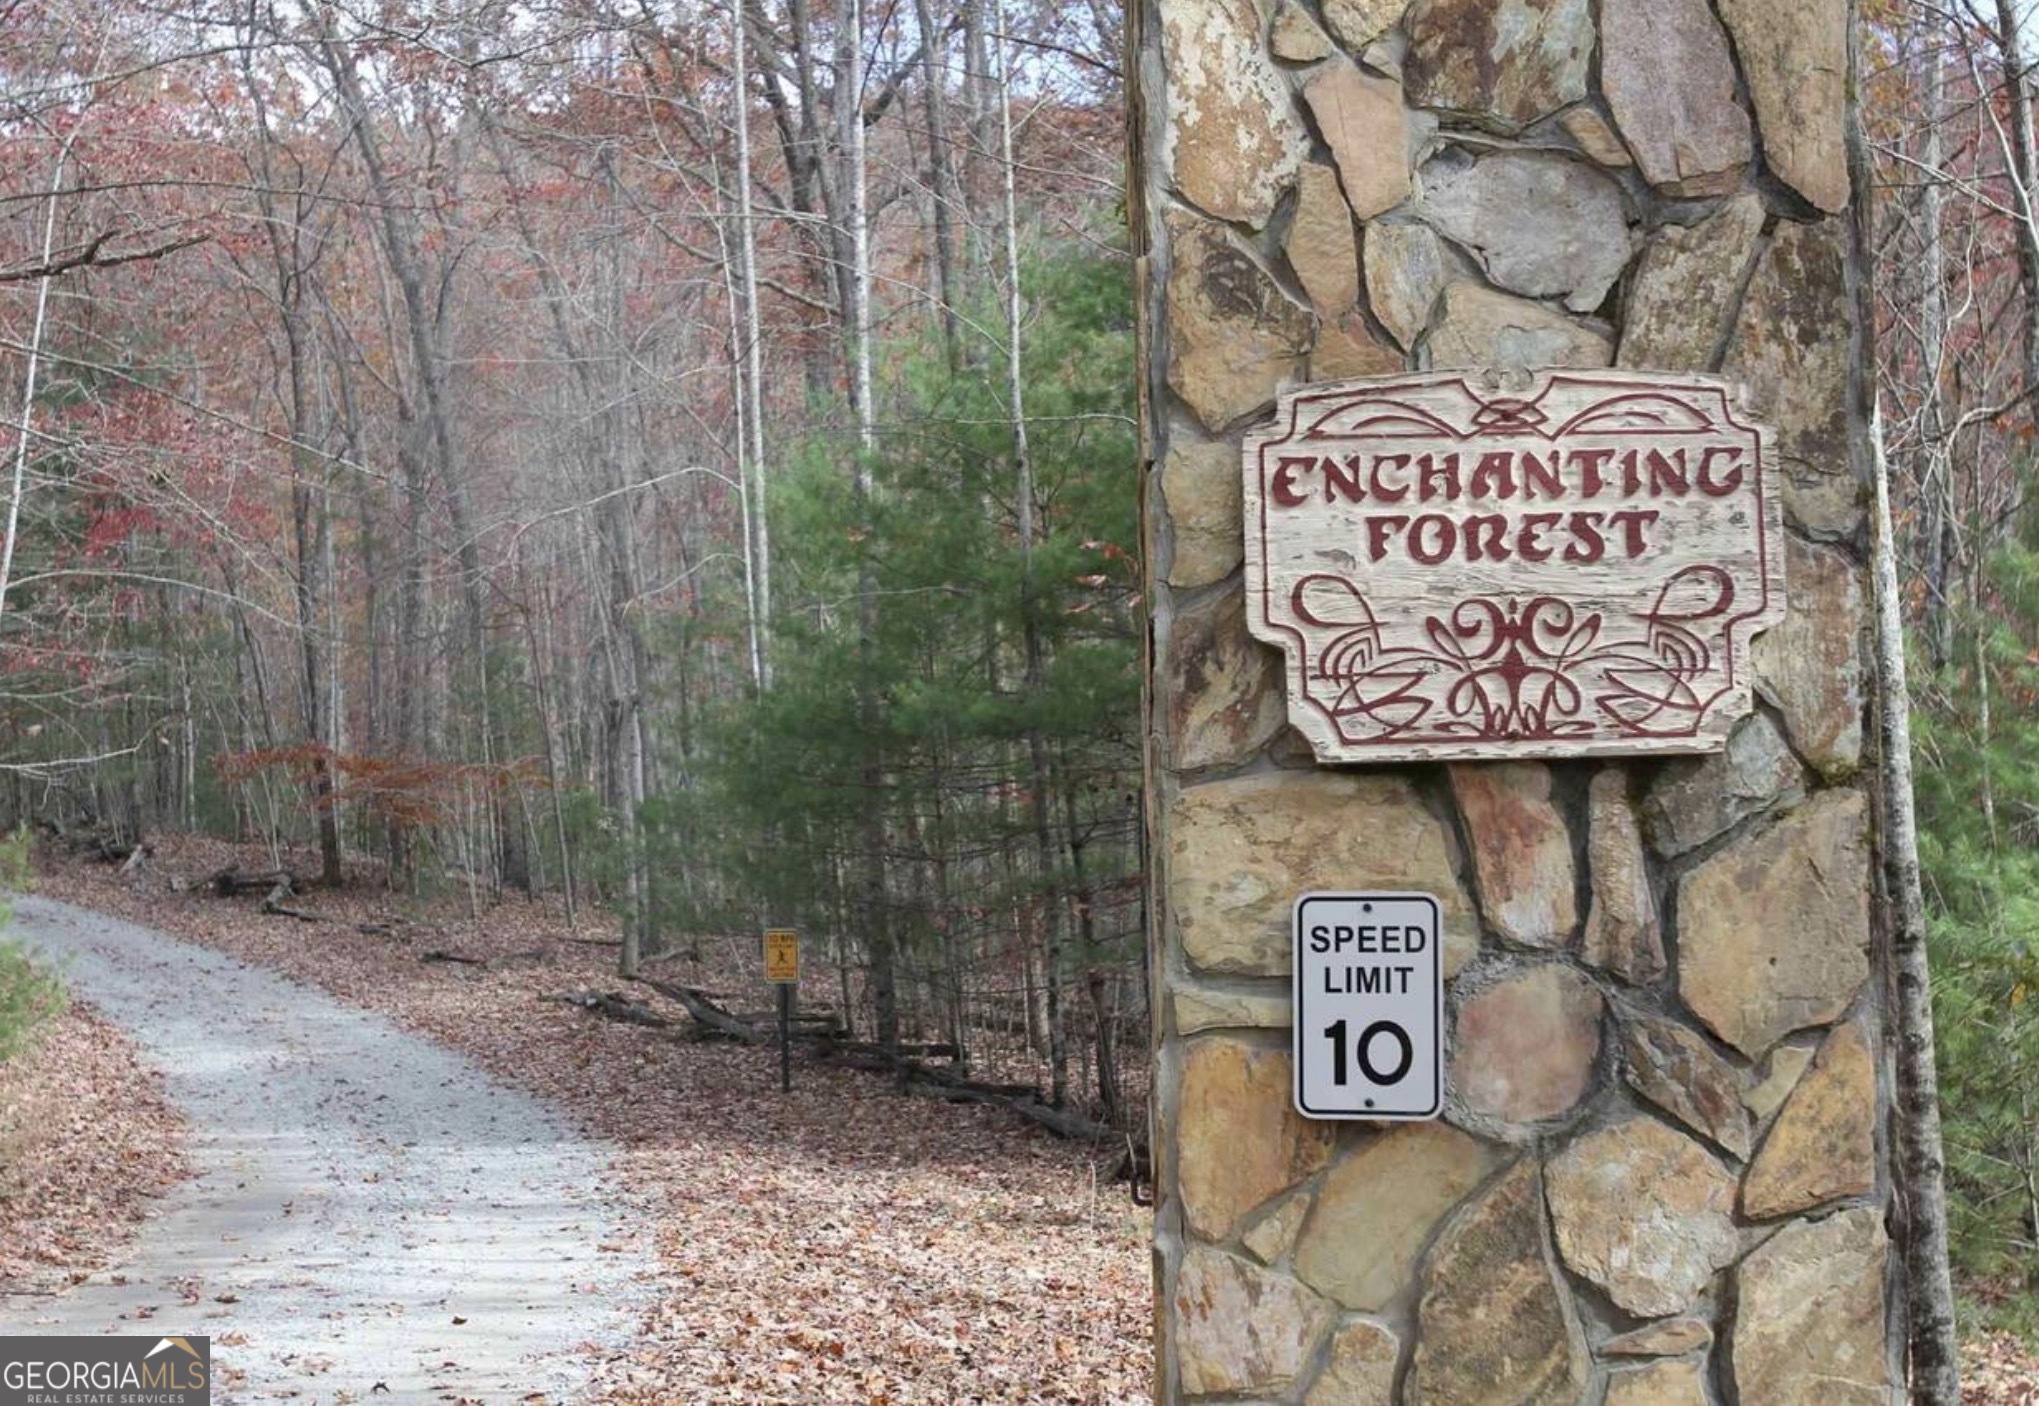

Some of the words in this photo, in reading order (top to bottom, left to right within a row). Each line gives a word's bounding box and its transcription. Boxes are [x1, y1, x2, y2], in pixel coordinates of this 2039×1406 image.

[1272, 448, 1743, 506] ENCHANTING
[1366, 510, 1659, 565] FOREST
[1310, 925, 1426, 953] SPEED
[1324, 966, 1414, 994] LIMIT
[1323, 1019, 1414, 1087] 10
